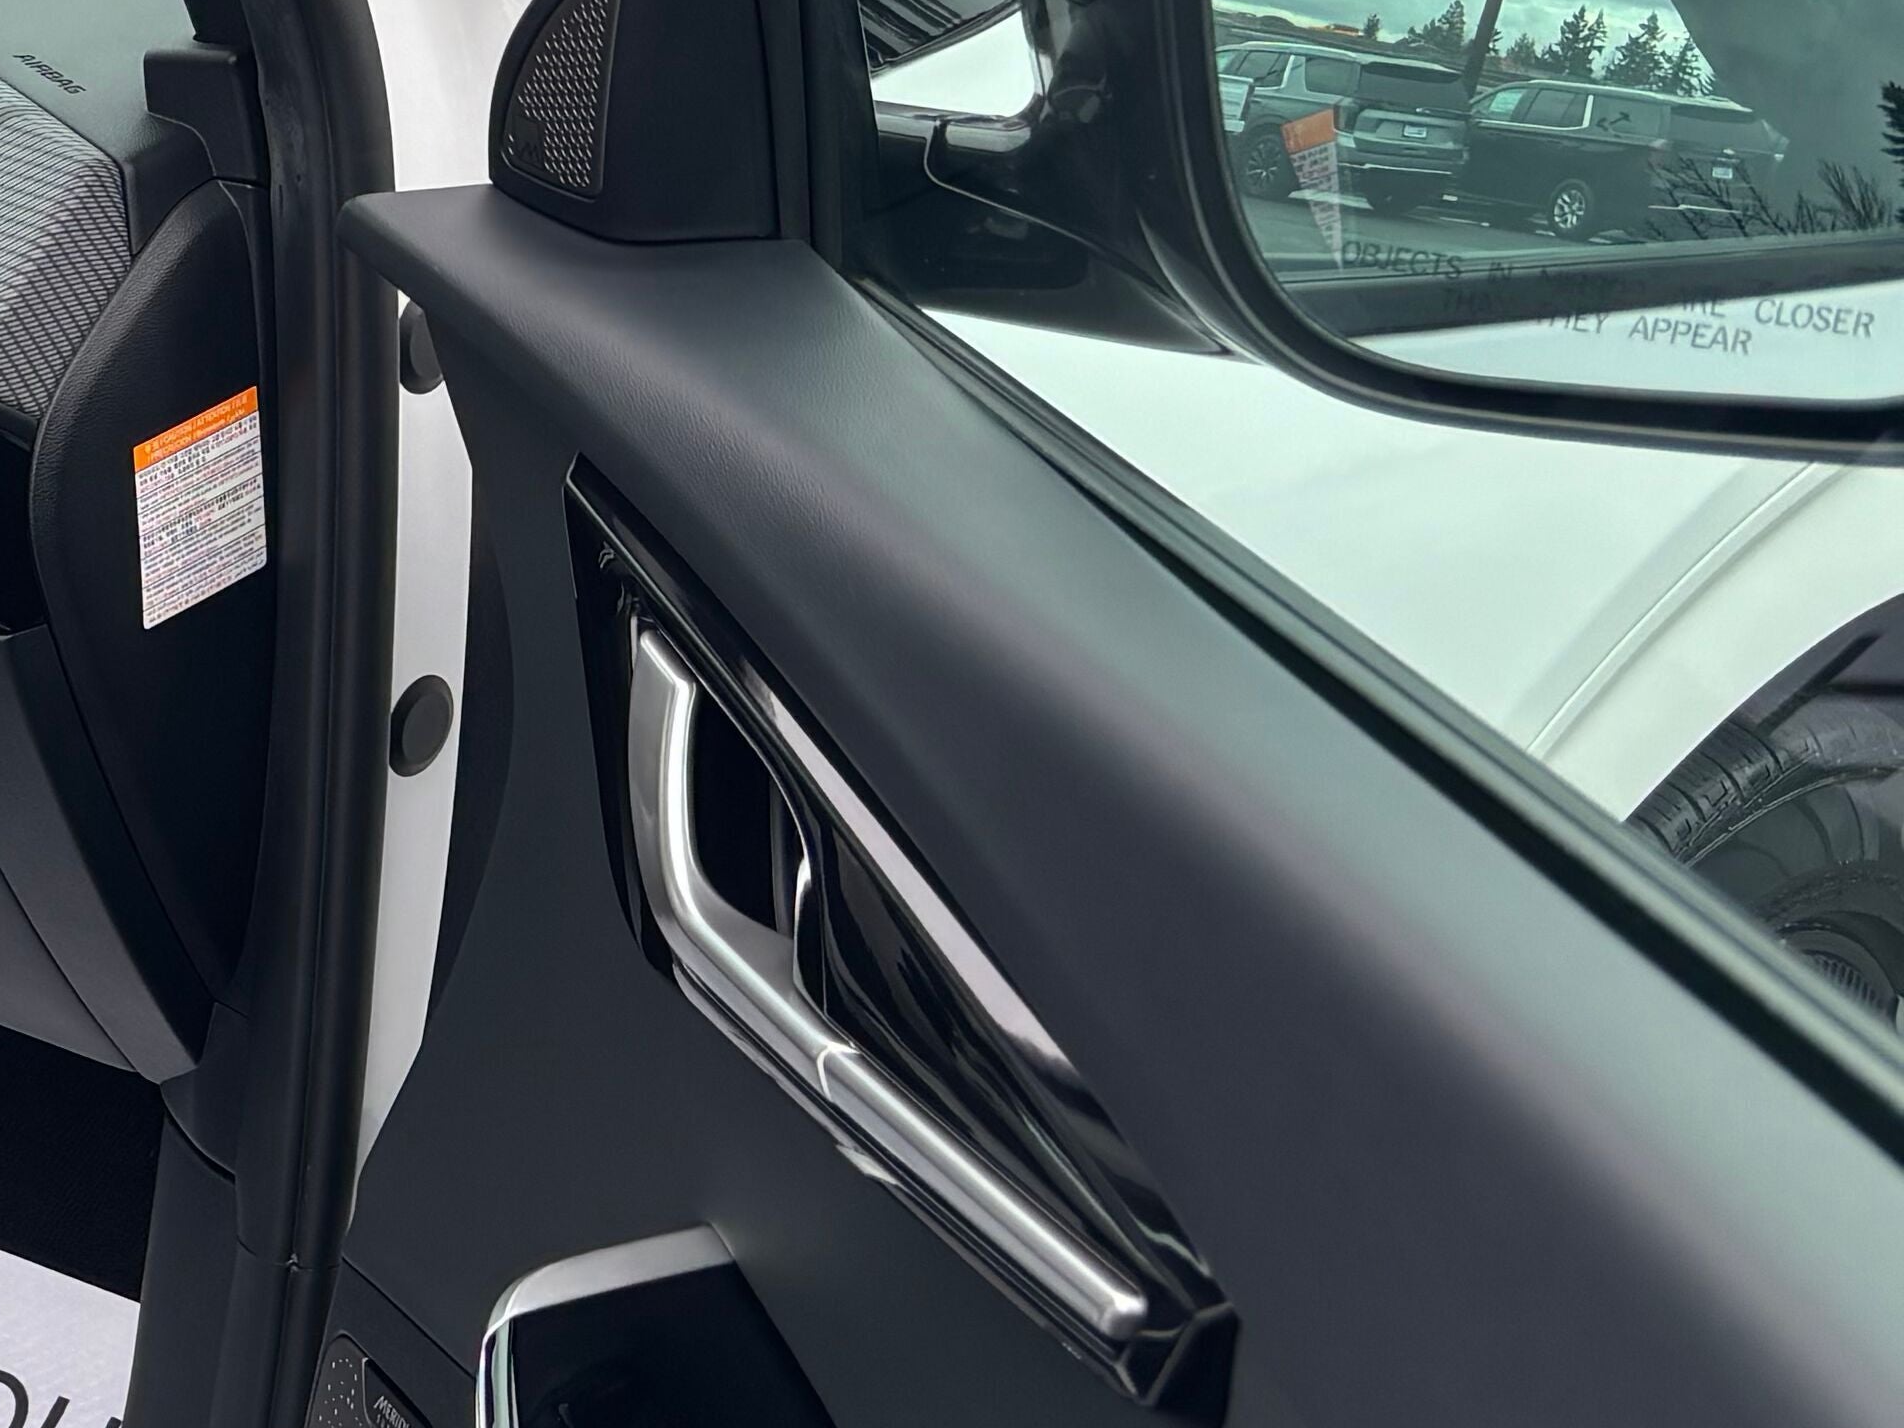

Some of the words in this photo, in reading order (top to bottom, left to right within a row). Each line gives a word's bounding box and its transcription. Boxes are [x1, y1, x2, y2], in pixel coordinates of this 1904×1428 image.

[13, 55, 87, 94] AIRBAG
[1340, 240, 1463, 280] OBJECTS
[1755, 297, 1875, 339] CLOSER
[1628, 315, 1753, 356] APPEAR
